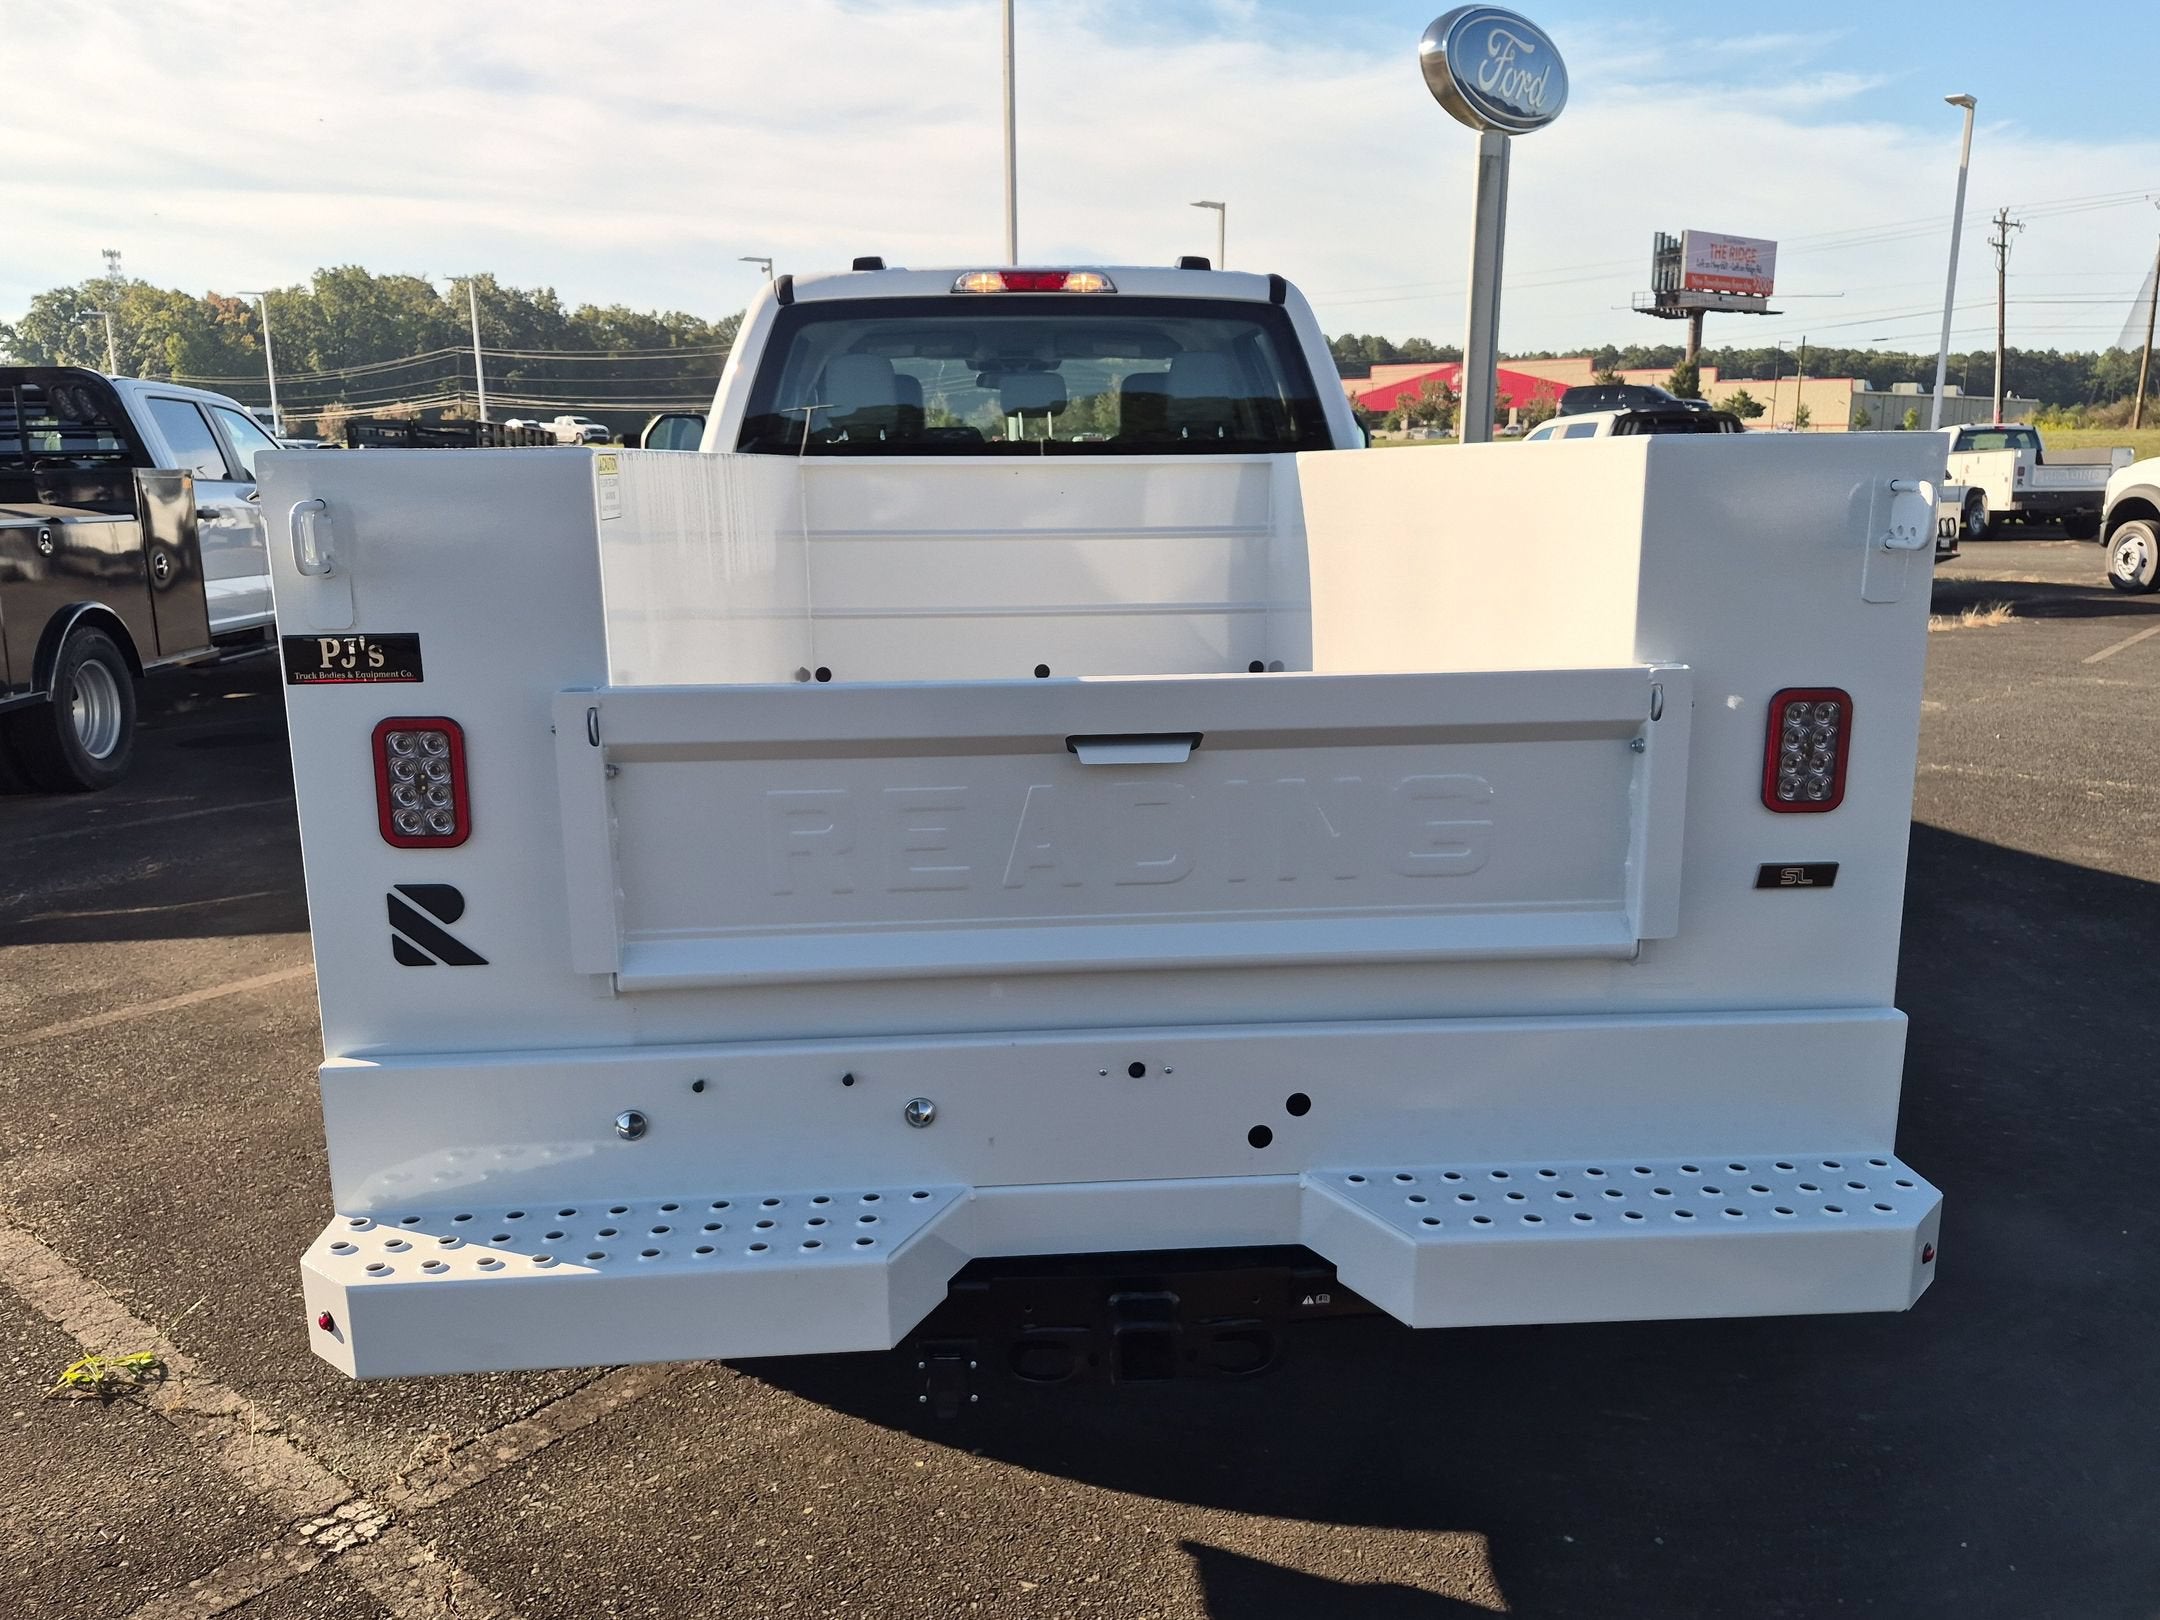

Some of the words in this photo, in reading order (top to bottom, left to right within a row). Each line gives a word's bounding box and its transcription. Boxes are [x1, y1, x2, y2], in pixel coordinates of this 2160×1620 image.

[1478, 28, 1550, 108] Ford
[1710, 242, 1726, 260] THE
[317, 635, 385, 669] PJ's
[294, 672, 318, 680] Truck
[319, 671, 346, 679] Bodies
[347, 671, 353, 679] &
[355, 671, 399, 681] Equipment
[400, 669, 414, 678] Co.
[1780, 868, 1813, 885] SL
